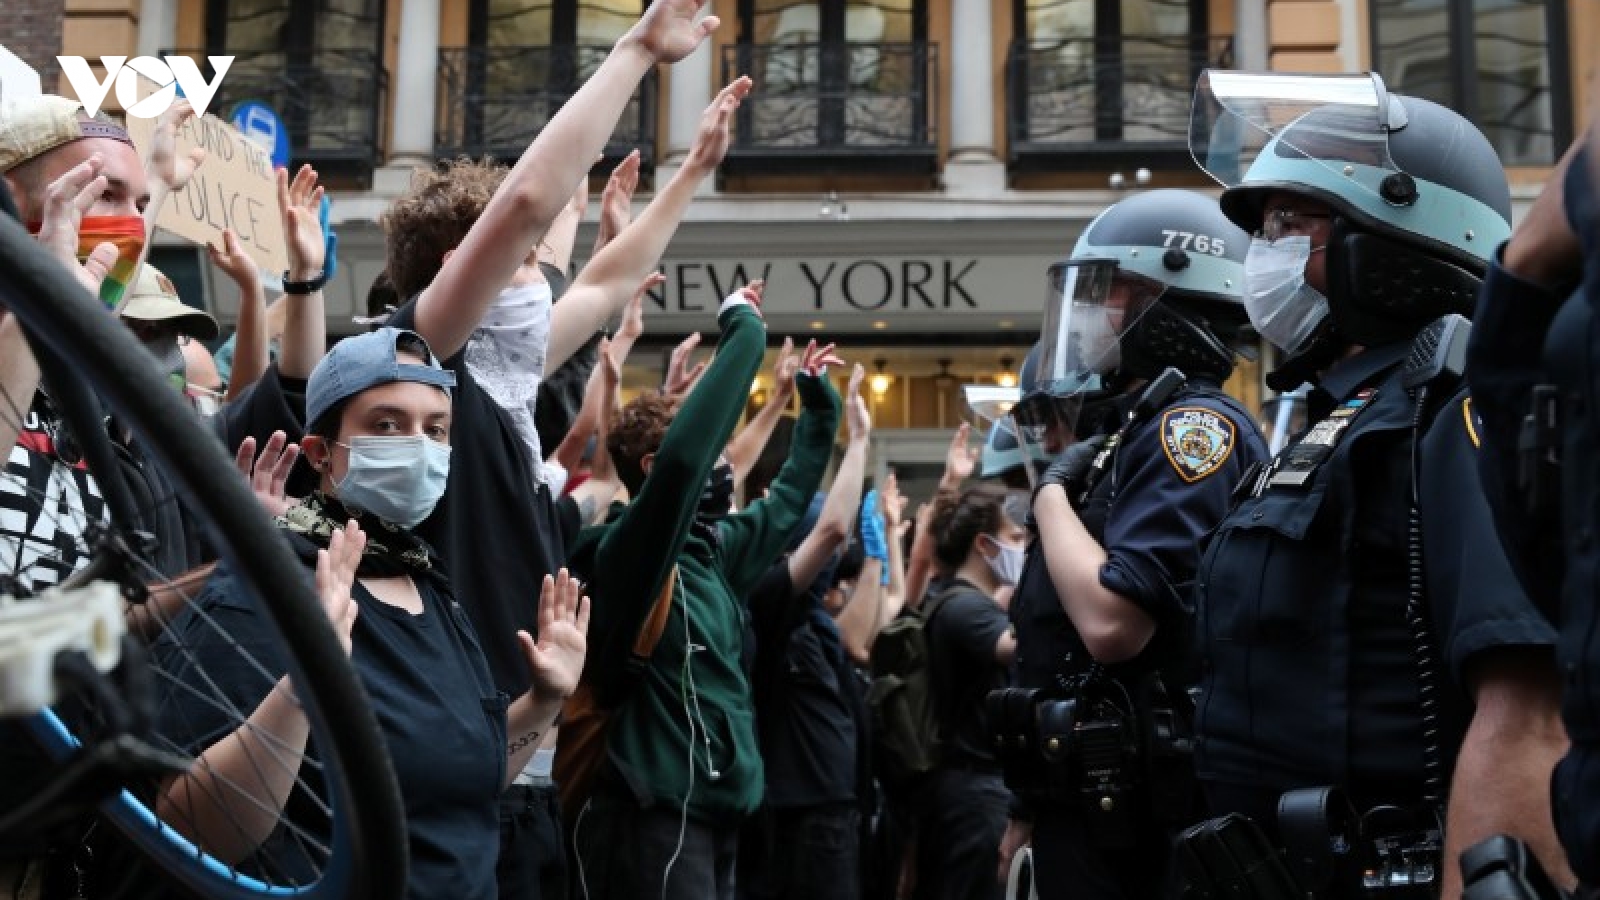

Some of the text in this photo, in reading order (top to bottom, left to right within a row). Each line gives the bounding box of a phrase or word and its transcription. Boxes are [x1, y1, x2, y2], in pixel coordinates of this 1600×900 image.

[1162, 230, 1224, 257] 7765
[643, 259, 979, 312] NEW YORK
